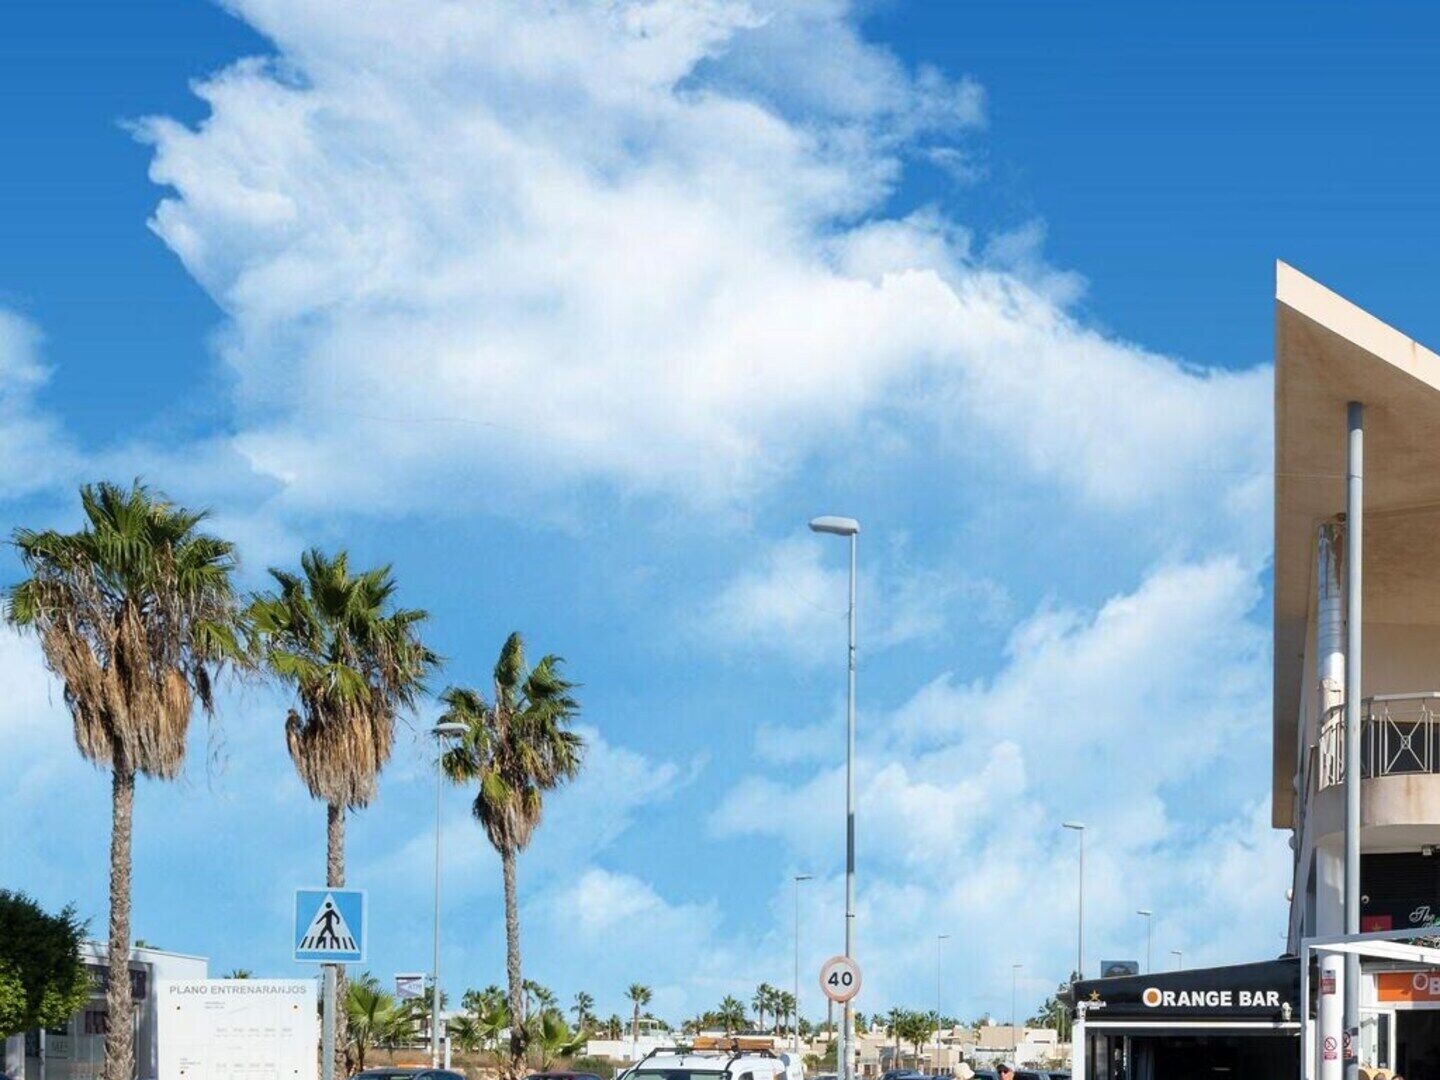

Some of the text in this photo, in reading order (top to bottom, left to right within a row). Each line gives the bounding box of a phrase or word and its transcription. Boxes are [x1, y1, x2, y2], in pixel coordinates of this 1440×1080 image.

[828, 971, 853, 987] 40
[169, 984, 307, 995] PLANO ENTRENARANJOS
[1143, 987, 1280, 1007] ORANGE BAR
